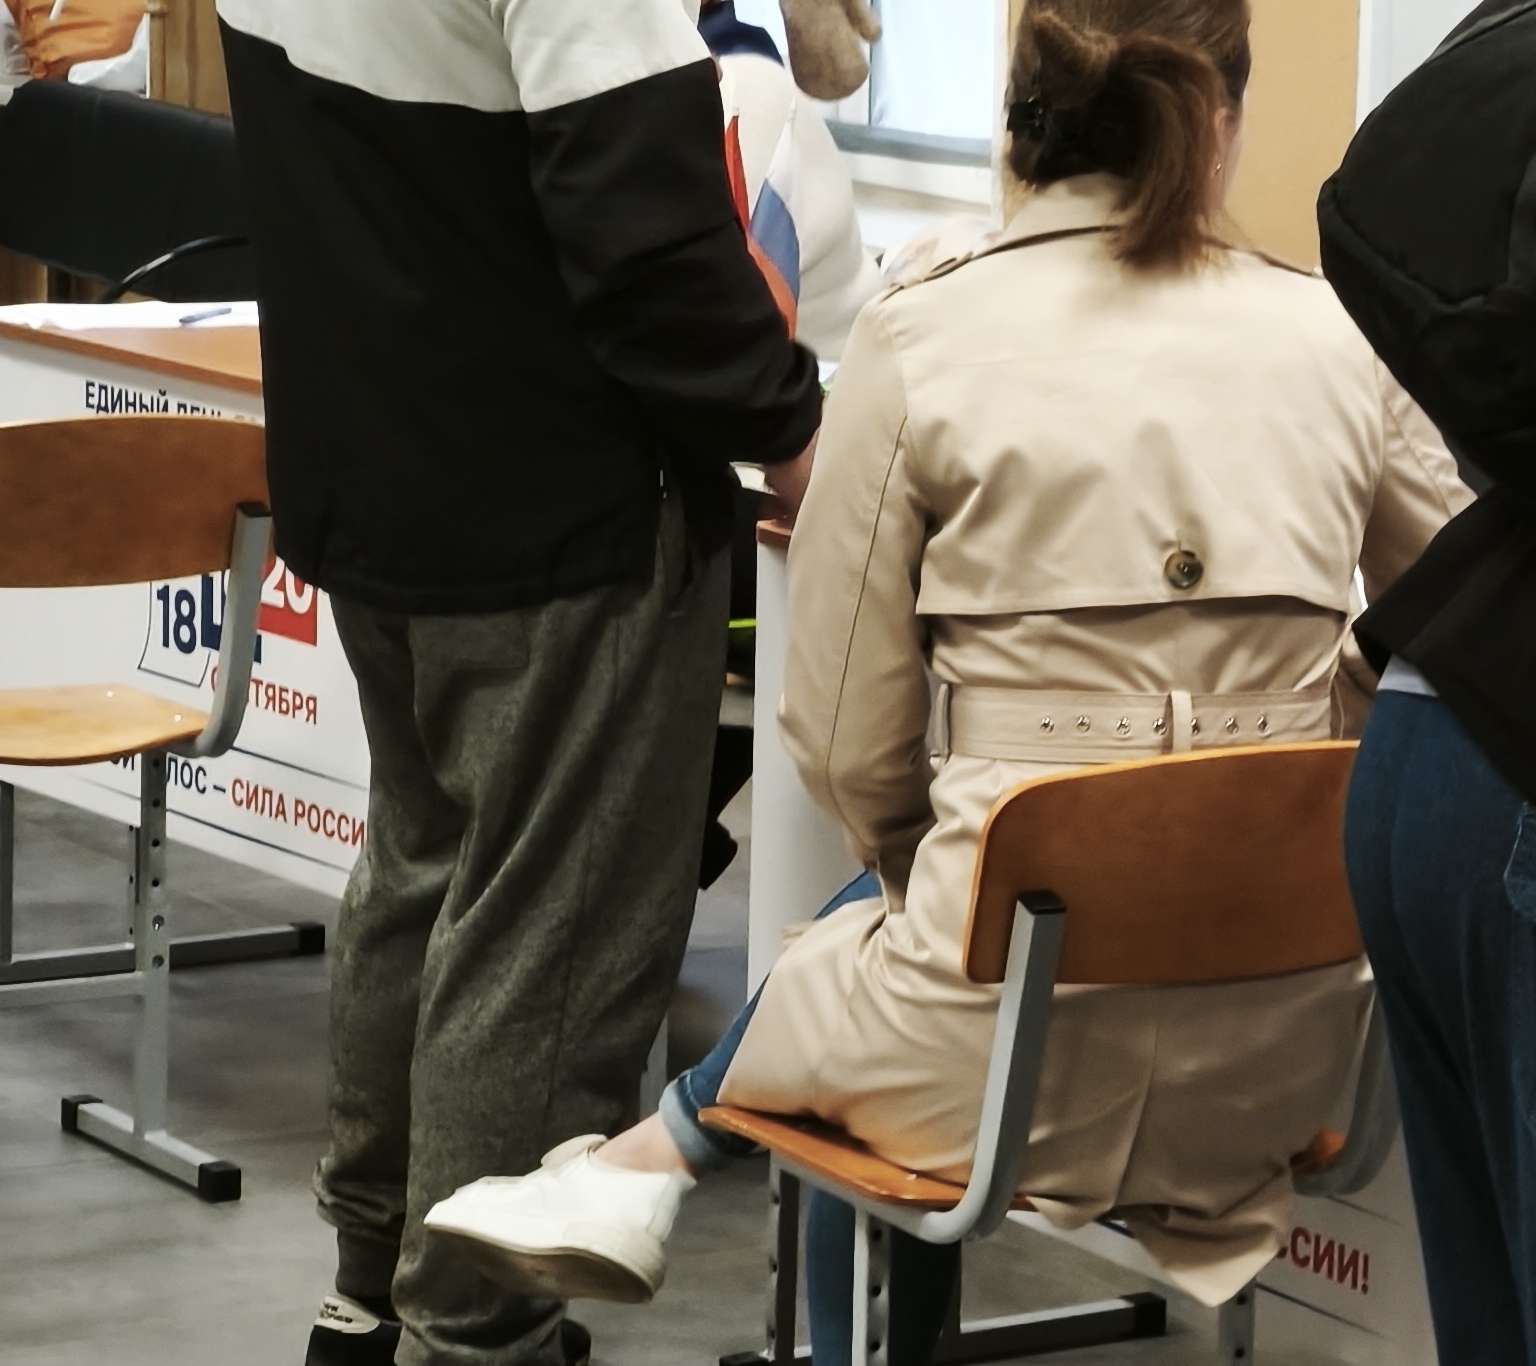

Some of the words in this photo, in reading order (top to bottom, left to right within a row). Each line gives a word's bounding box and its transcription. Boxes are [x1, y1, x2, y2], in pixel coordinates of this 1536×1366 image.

[85, 379, 170, 416] ЕДИНЫЙ
[156, 583, 198, 655] 18
[167, 755, 208, 795] ЛОС
[231, 777, 288, 825] СИЛА
[294, 798, 366, 848] РОССИ
[1277, 1226, 1370, 1296] СИИ!
